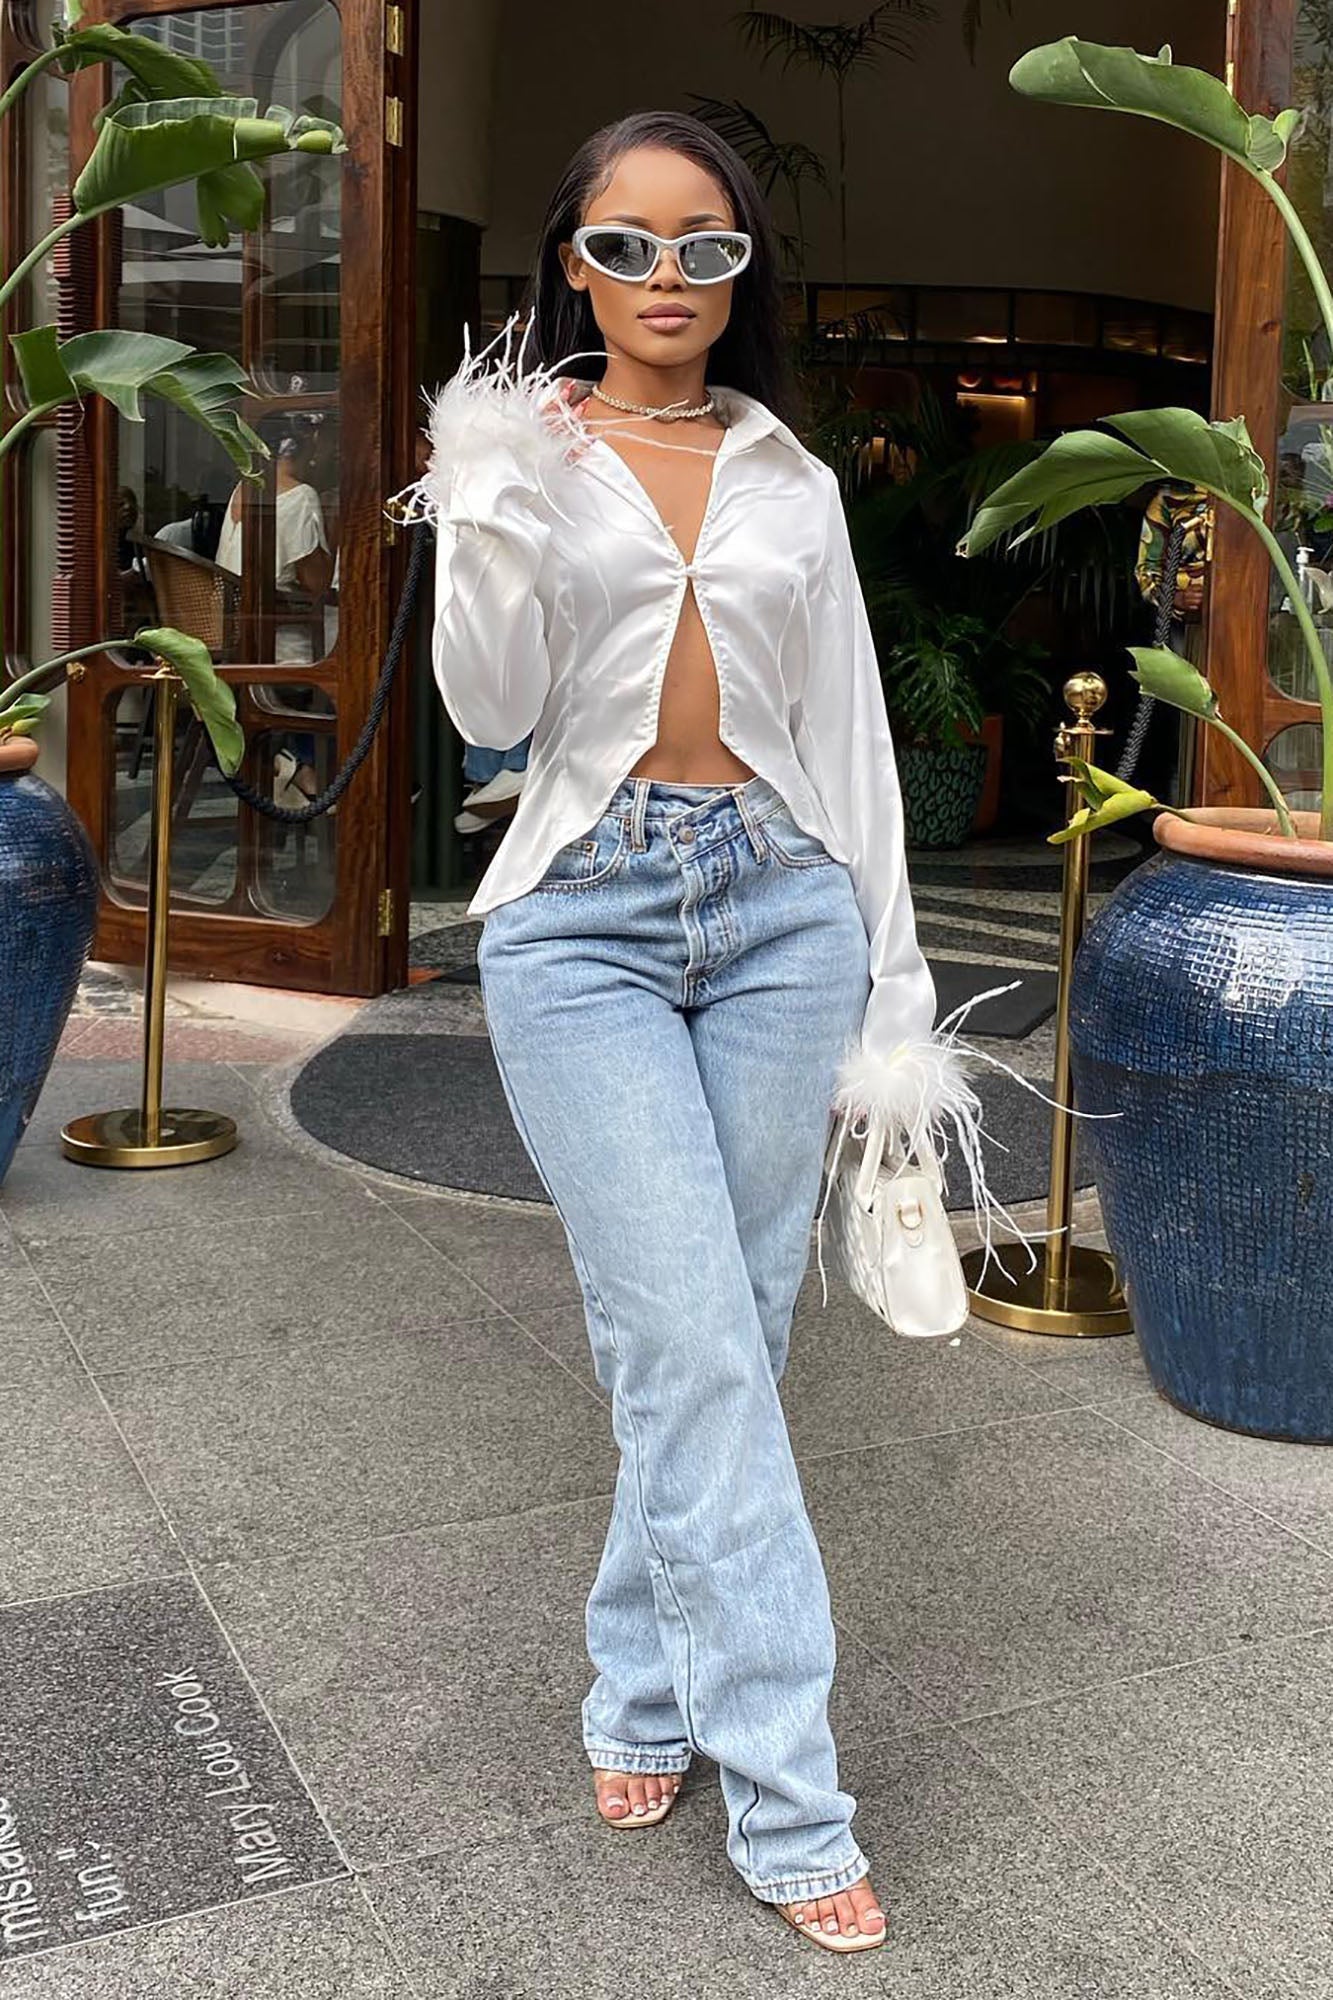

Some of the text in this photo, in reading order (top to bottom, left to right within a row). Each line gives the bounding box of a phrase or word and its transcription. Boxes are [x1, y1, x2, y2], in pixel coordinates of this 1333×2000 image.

[155, 1666, 293, 1883] Mary Lou Cook
[0, 1798, 49, 1943] mista
